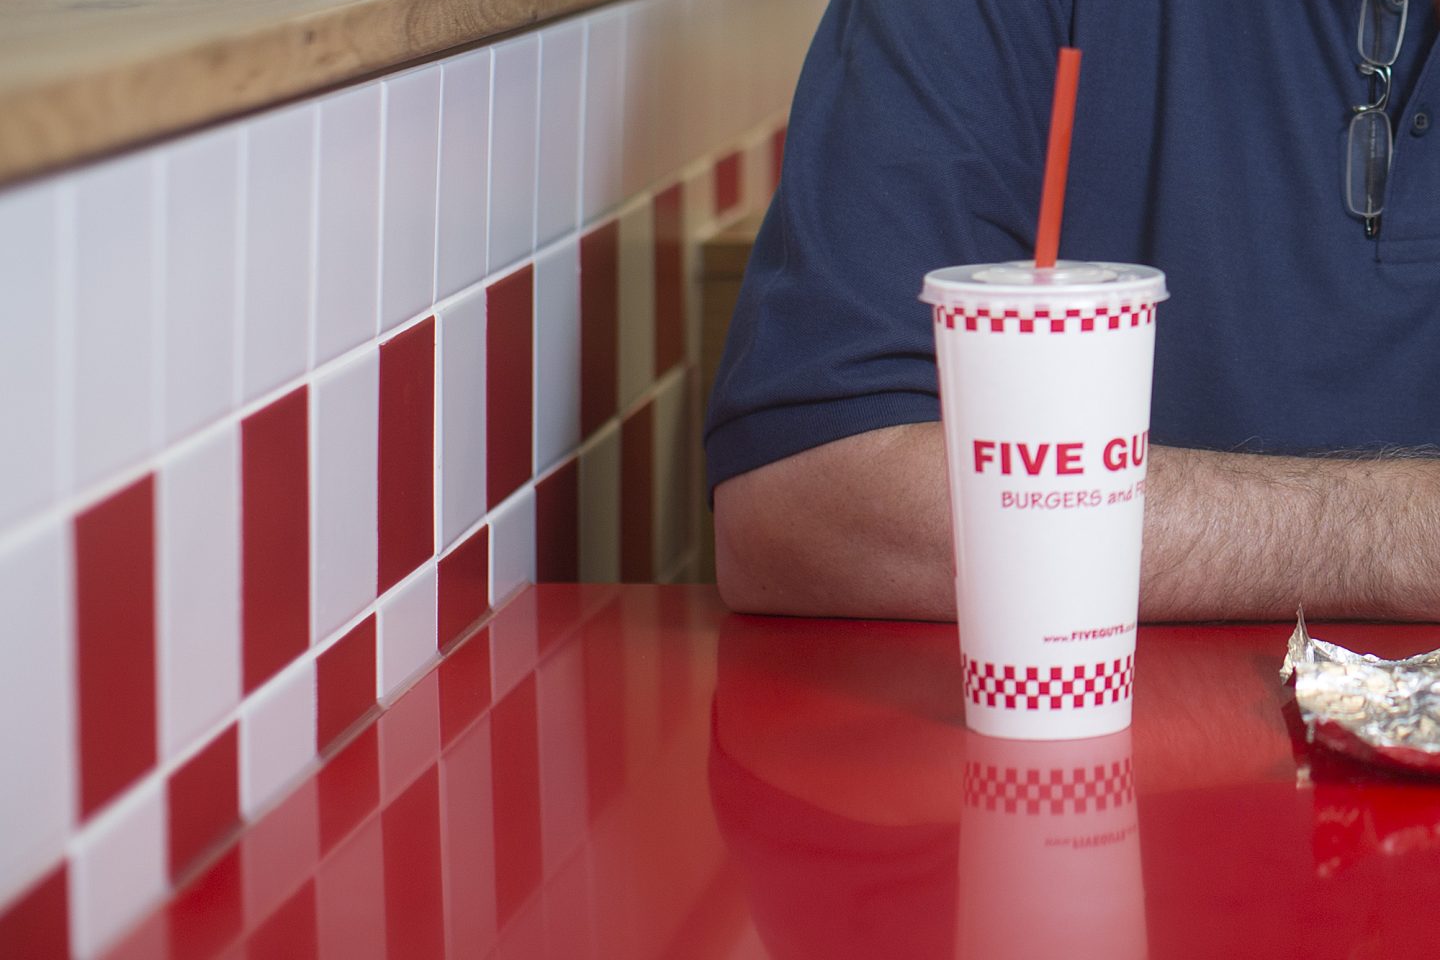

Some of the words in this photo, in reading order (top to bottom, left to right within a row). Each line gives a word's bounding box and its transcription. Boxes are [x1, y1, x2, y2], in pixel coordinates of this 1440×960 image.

[973, 439, 1085, 476] FIVE
[1102, 430, 1150, 472] GU
[1001, 490, 1102, 510] BURGERS
[1107, 481, 1134, 505] and
